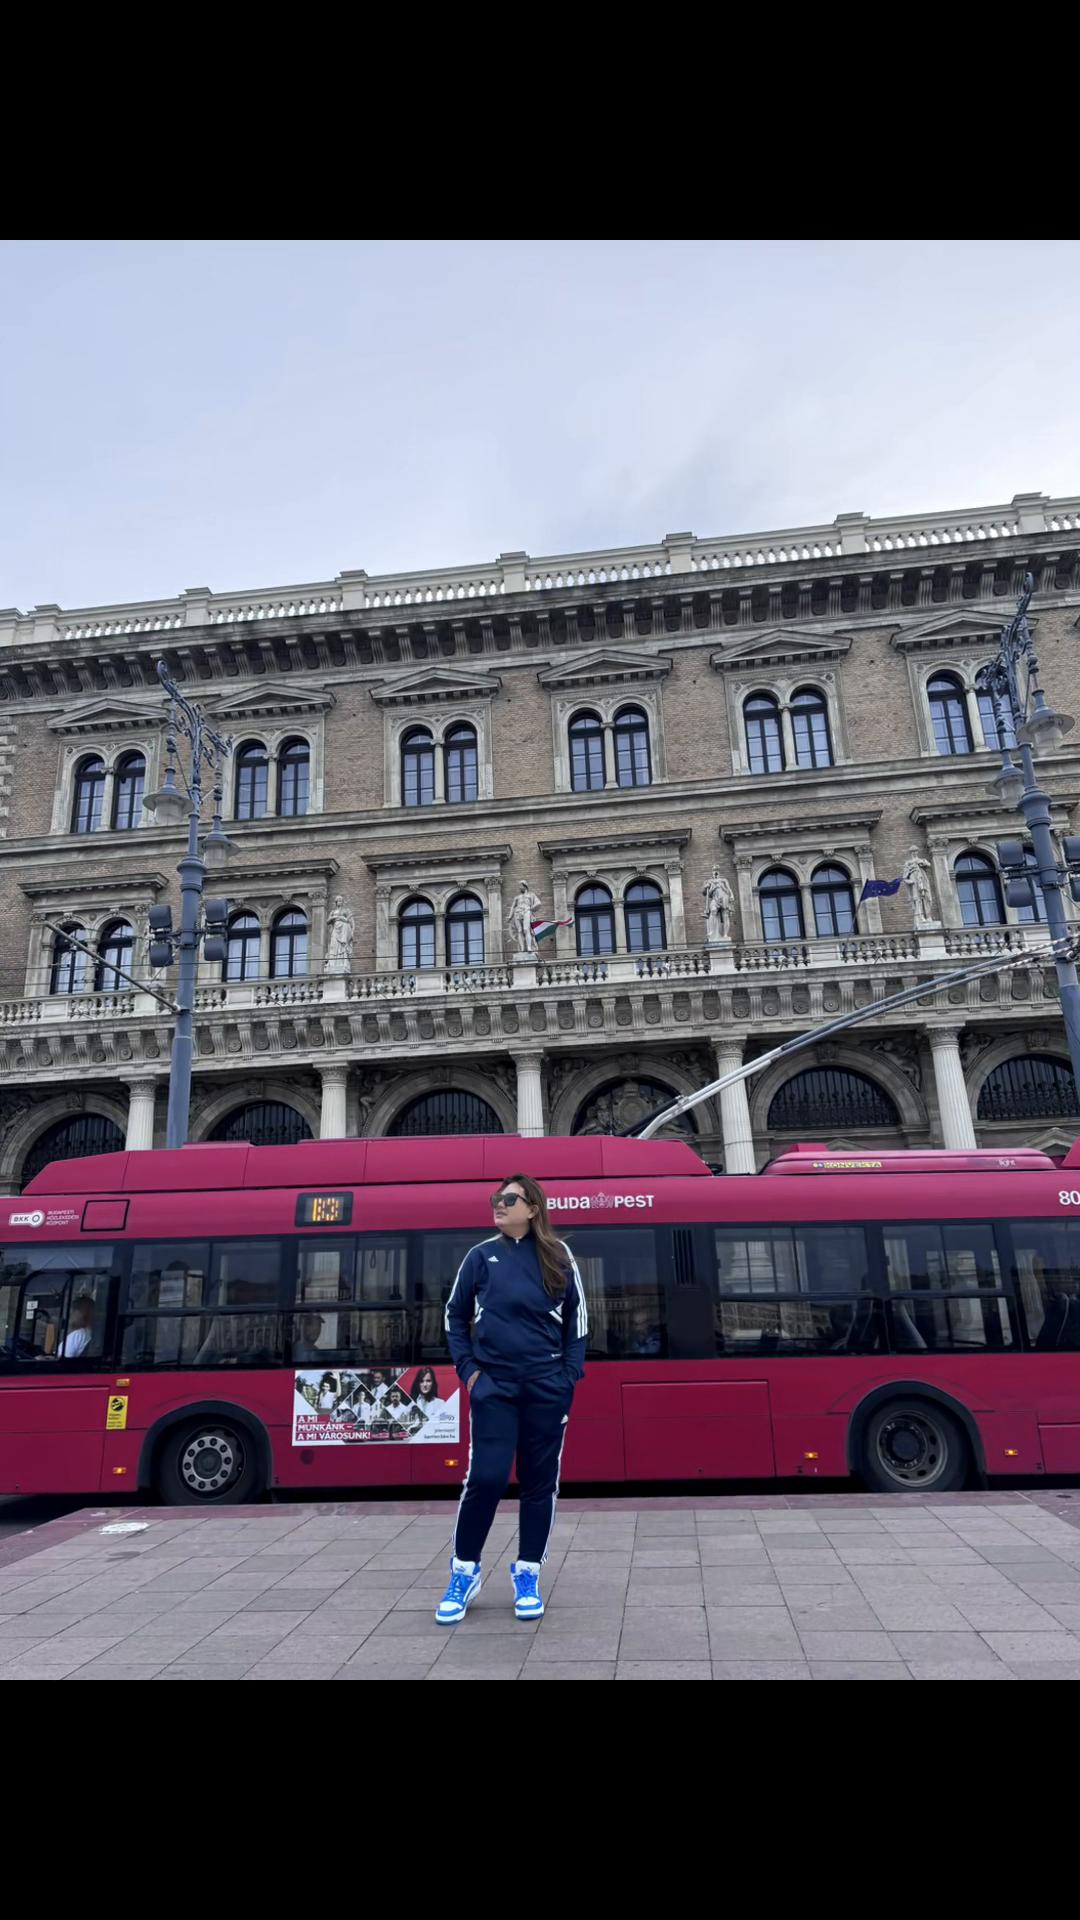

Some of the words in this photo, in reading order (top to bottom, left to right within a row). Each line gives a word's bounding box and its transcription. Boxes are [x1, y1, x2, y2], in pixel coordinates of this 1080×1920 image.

[1058, 1190, 1080, 1206] 80
[297, 1415, 306, 1423] A
[307, 1415, 318, 1423] MI
[297, 1422, 345, 1431] MUNKÁNK
[297, 1432, 305, 1440] A
[306, 1432, 317, 1440] MI
[319, 1431, 371, 1440] VÁROSUNK!
